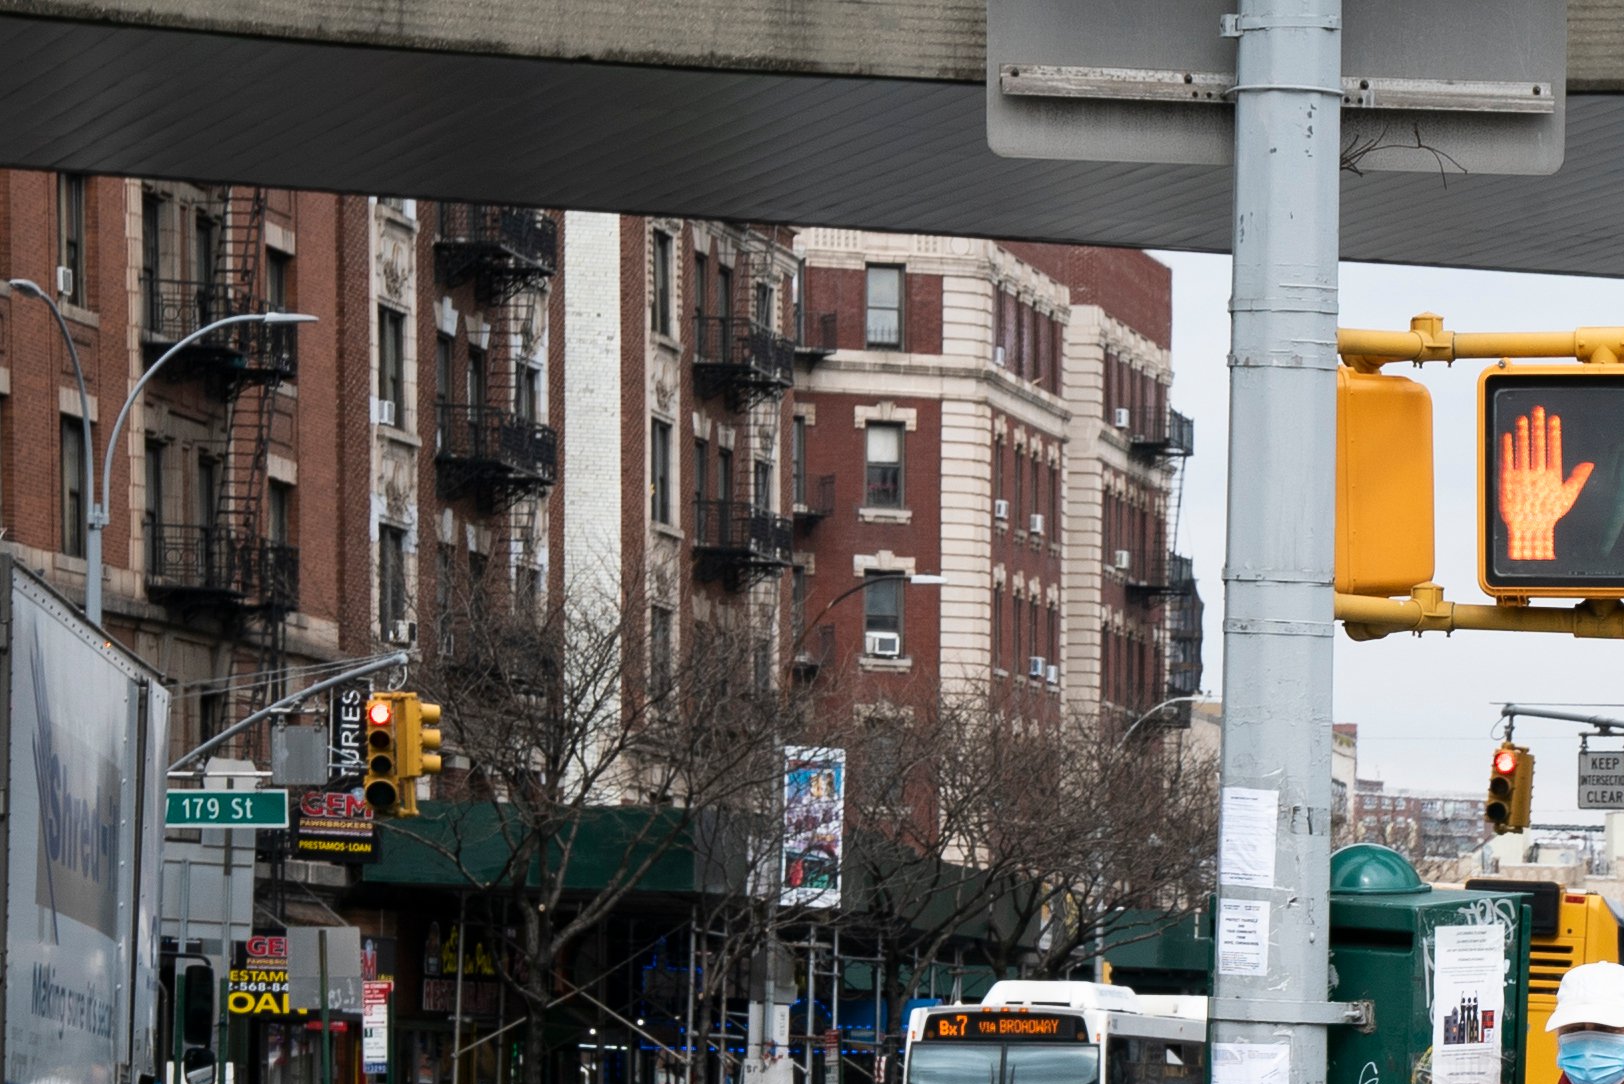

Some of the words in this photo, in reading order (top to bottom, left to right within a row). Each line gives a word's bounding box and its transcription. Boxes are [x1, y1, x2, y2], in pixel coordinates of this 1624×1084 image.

[1591, 758, 1620, 770] KEEP
[182, 798, 221, 819] 179
[231, 797, 254, 819] St
[301, 790, 374, 819] GEM
[1586, 791, 1624, 804] CLEAR
[246, 936, 288, 957] GE
[939, 1014, 968, 1036] Bx7
[979, 1021, 996, 1033] VIA
[1000, 1019, 1060, 1034] BROADWAY
